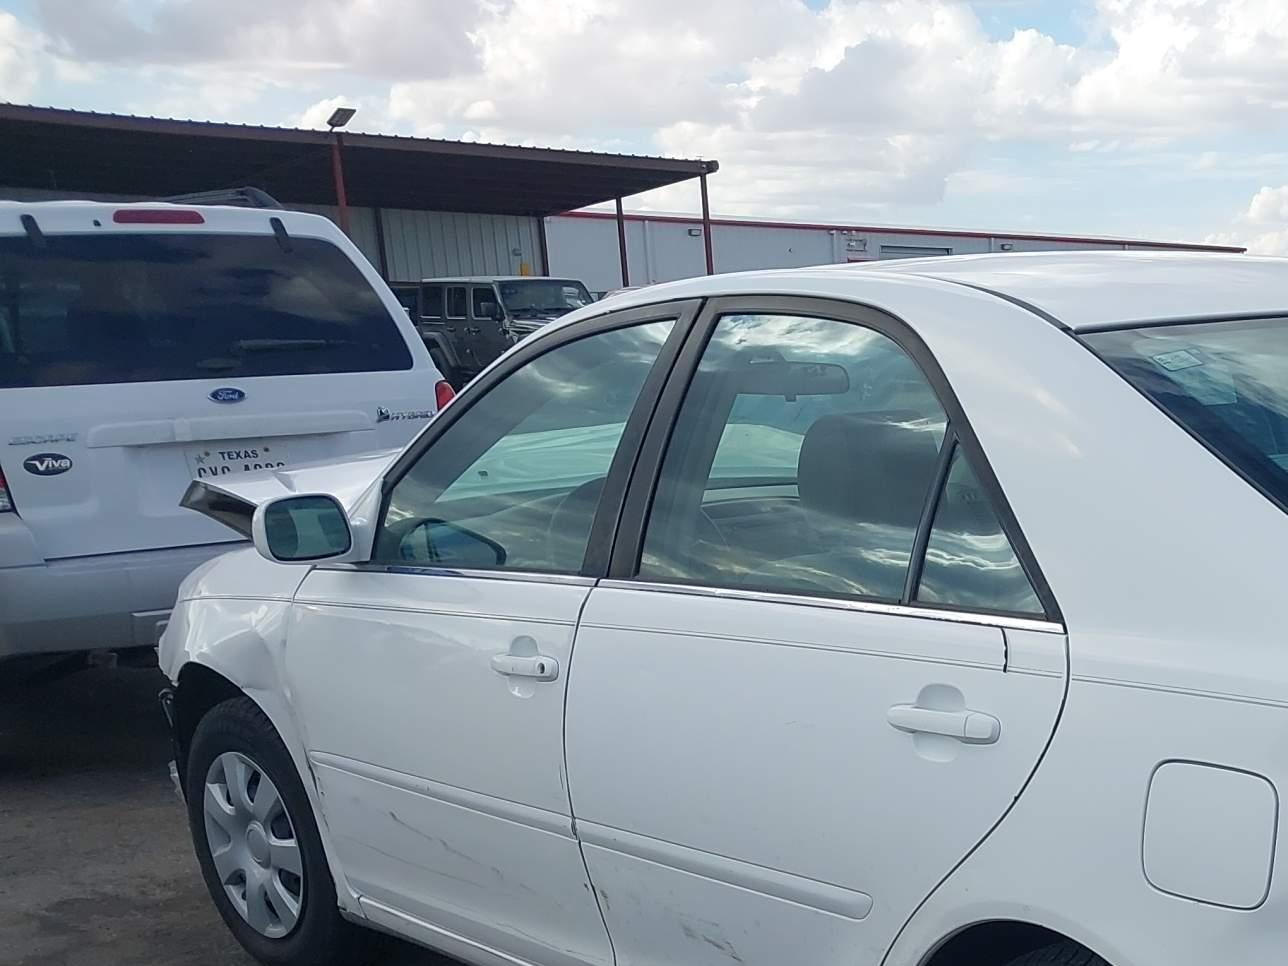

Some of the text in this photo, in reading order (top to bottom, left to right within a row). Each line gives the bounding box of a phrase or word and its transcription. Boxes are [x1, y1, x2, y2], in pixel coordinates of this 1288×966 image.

[216, 389, 240, 401] Ford
[218, 449, 259, 461] TEXAS
[25, 457, 71, 471] Viva
